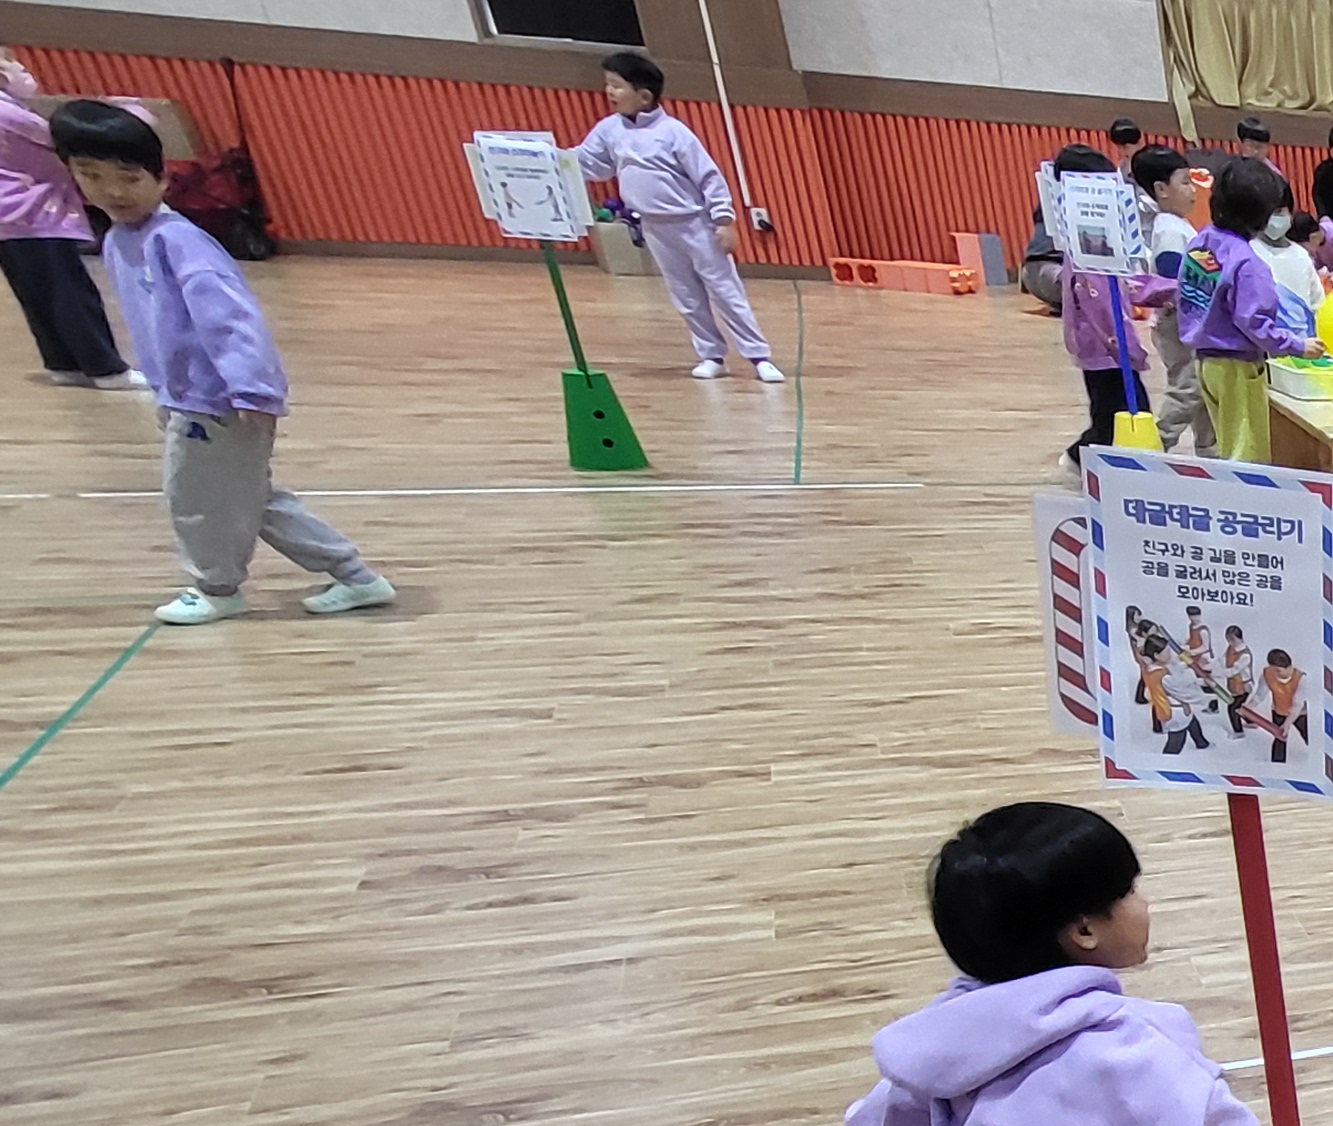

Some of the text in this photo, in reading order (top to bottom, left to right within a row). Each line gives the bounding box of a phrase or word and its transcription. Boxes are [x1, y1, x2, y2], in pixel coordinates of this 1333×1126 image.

[1122, 498, 1303, 544] 데굴데굴 공굴리기
[1142, 539, 1284, 571] 친구와 공 길을 만들어
[1141, 560, 1283, 592] 공을 굴려서 많은 공을
[1177, 585, 1254, 607] 모아보아요!
